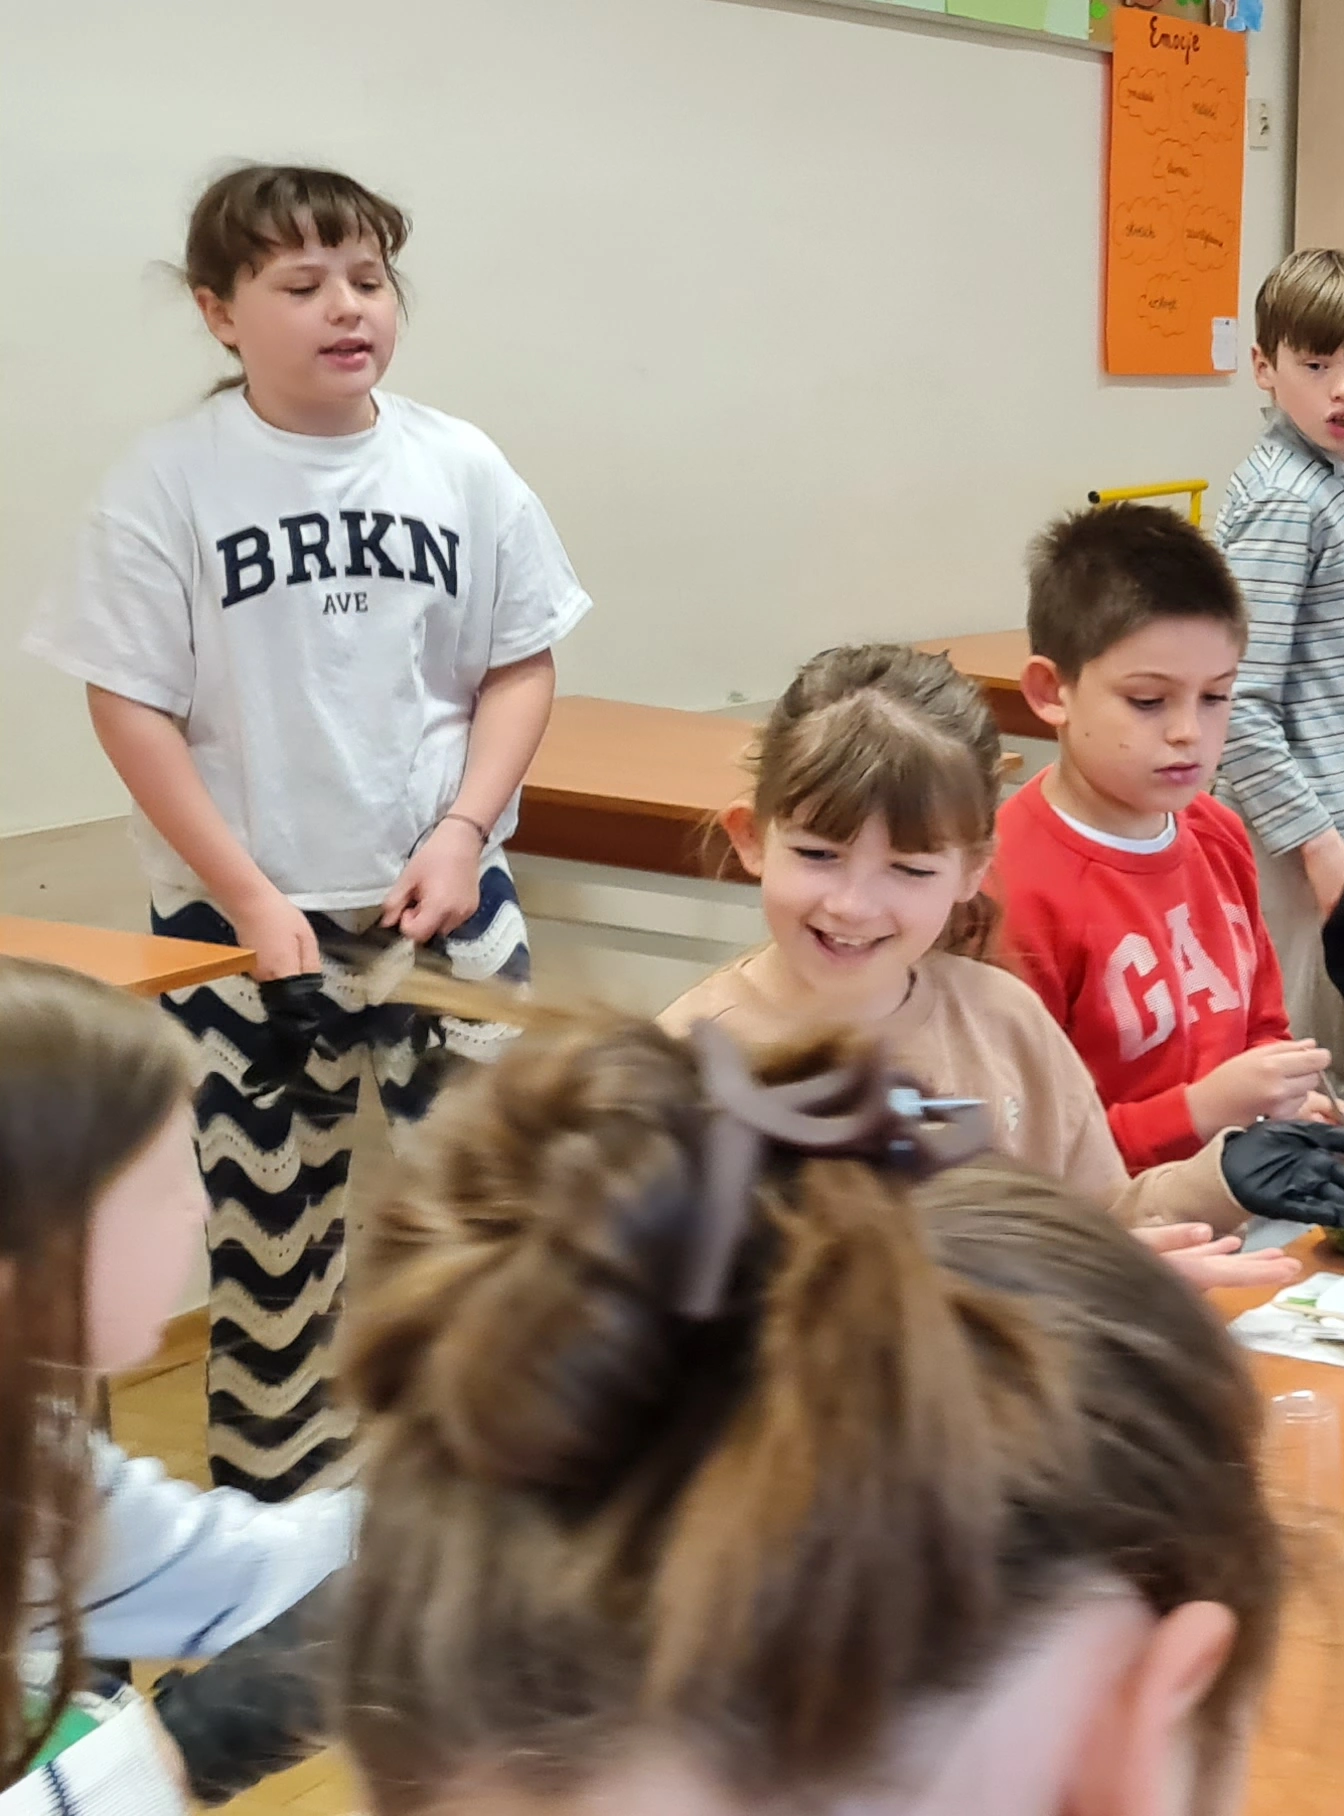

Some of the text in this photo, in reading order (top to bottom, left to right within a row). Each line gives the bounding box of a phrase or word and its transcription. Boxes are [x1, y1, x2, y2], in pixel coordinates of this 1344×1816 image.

[1149, 15, 1201, 65] Emocje
[216, 507, 460, 609] BRKN
[321, 591, 369, 616] AVE
